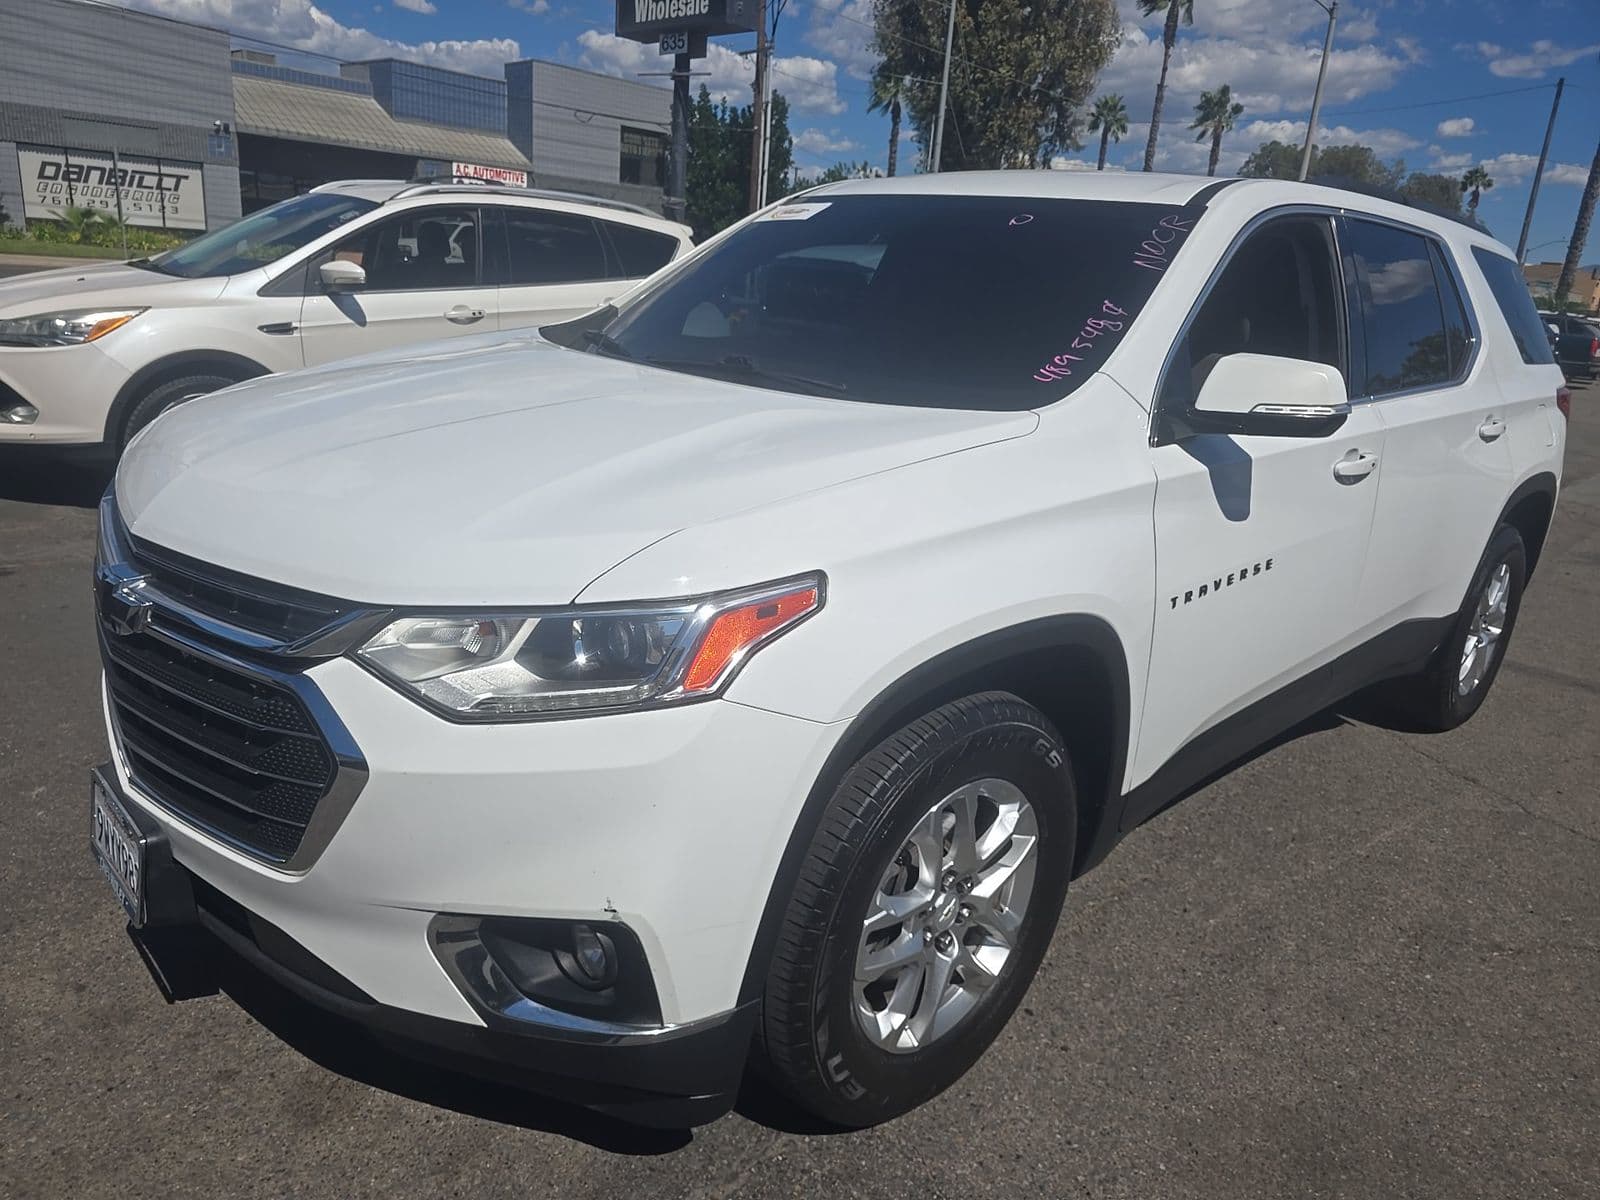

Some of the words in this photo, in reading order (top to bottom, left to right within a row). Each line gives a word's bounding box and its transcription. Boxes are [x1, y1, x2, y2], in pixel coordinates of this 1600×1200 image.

[634, 0, 709, 23] Wholesale
[661, 34, 685, 52] 635
[472, 166, 525, 183] AUTOMOTIVE
[1169, 558, 1274, 610] TRAVERSE
